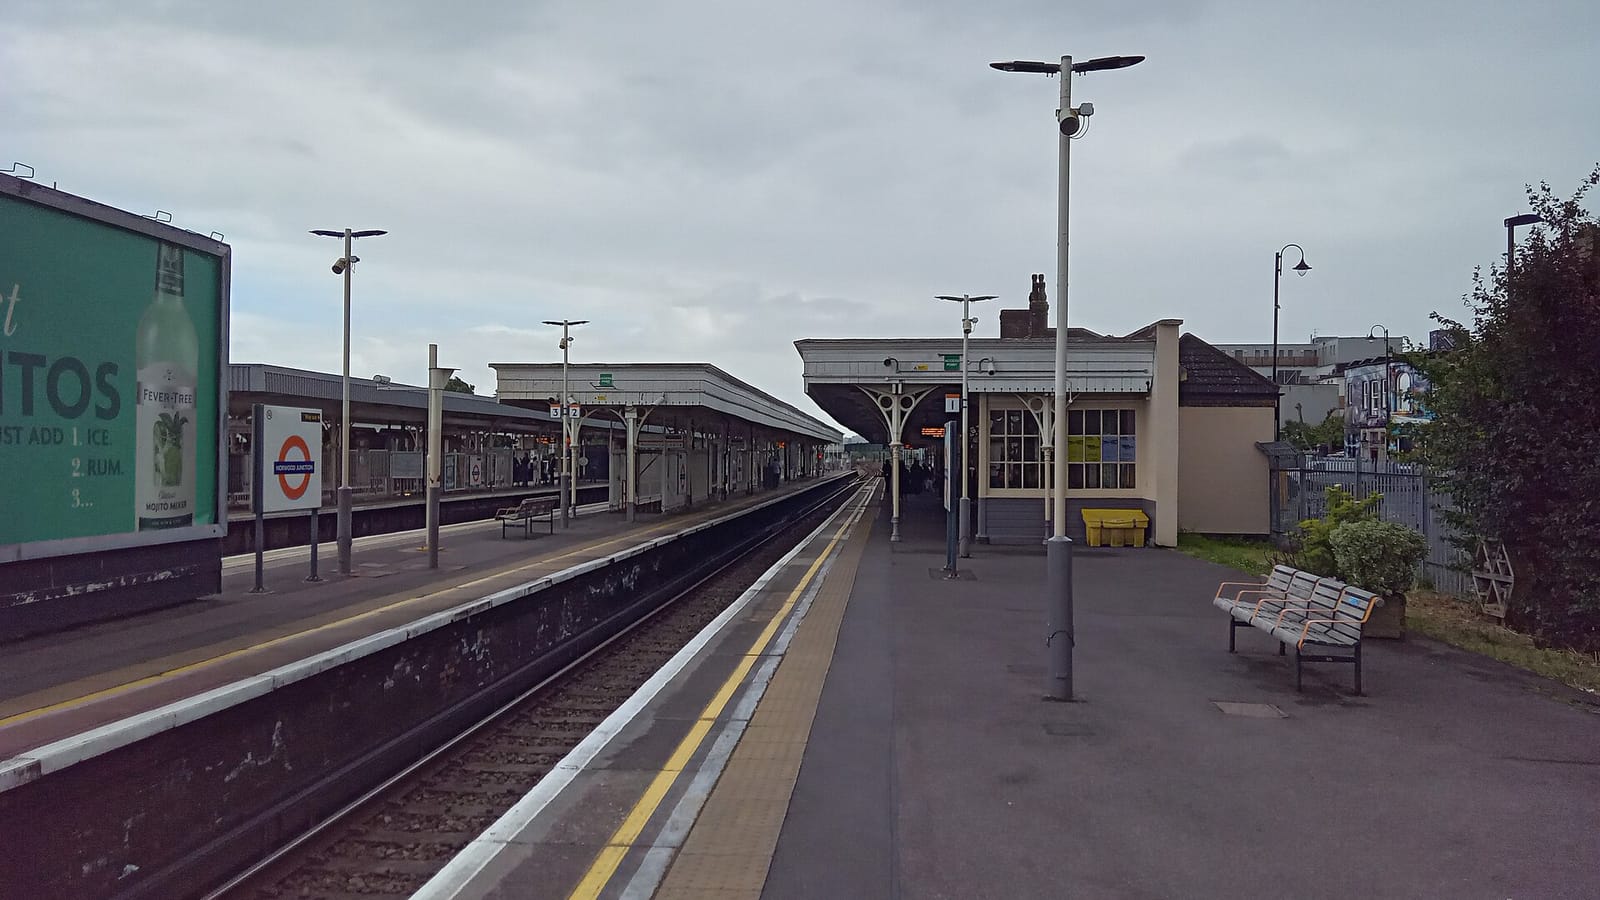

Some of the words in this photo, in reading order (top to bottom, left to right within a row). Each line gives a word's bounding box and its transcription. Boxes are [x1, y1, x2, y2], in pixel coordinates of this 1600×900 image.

[0, 283, 21, 337] t
[0, 351, 121, 421] TOS
[552, 408, 559, 416] 3
[571, 408, 577, 416] 2
[0, 426, 24, 445] ST
[28, 426, 64, 446] ADD
[72, 427, 83, 446] 1.
[87, 429, 112, 446] ICE.
[71, 457, 85, 477] 2.
[87, 458, 124, 477] RUM.
[71, 488, 94, 508] 3...
